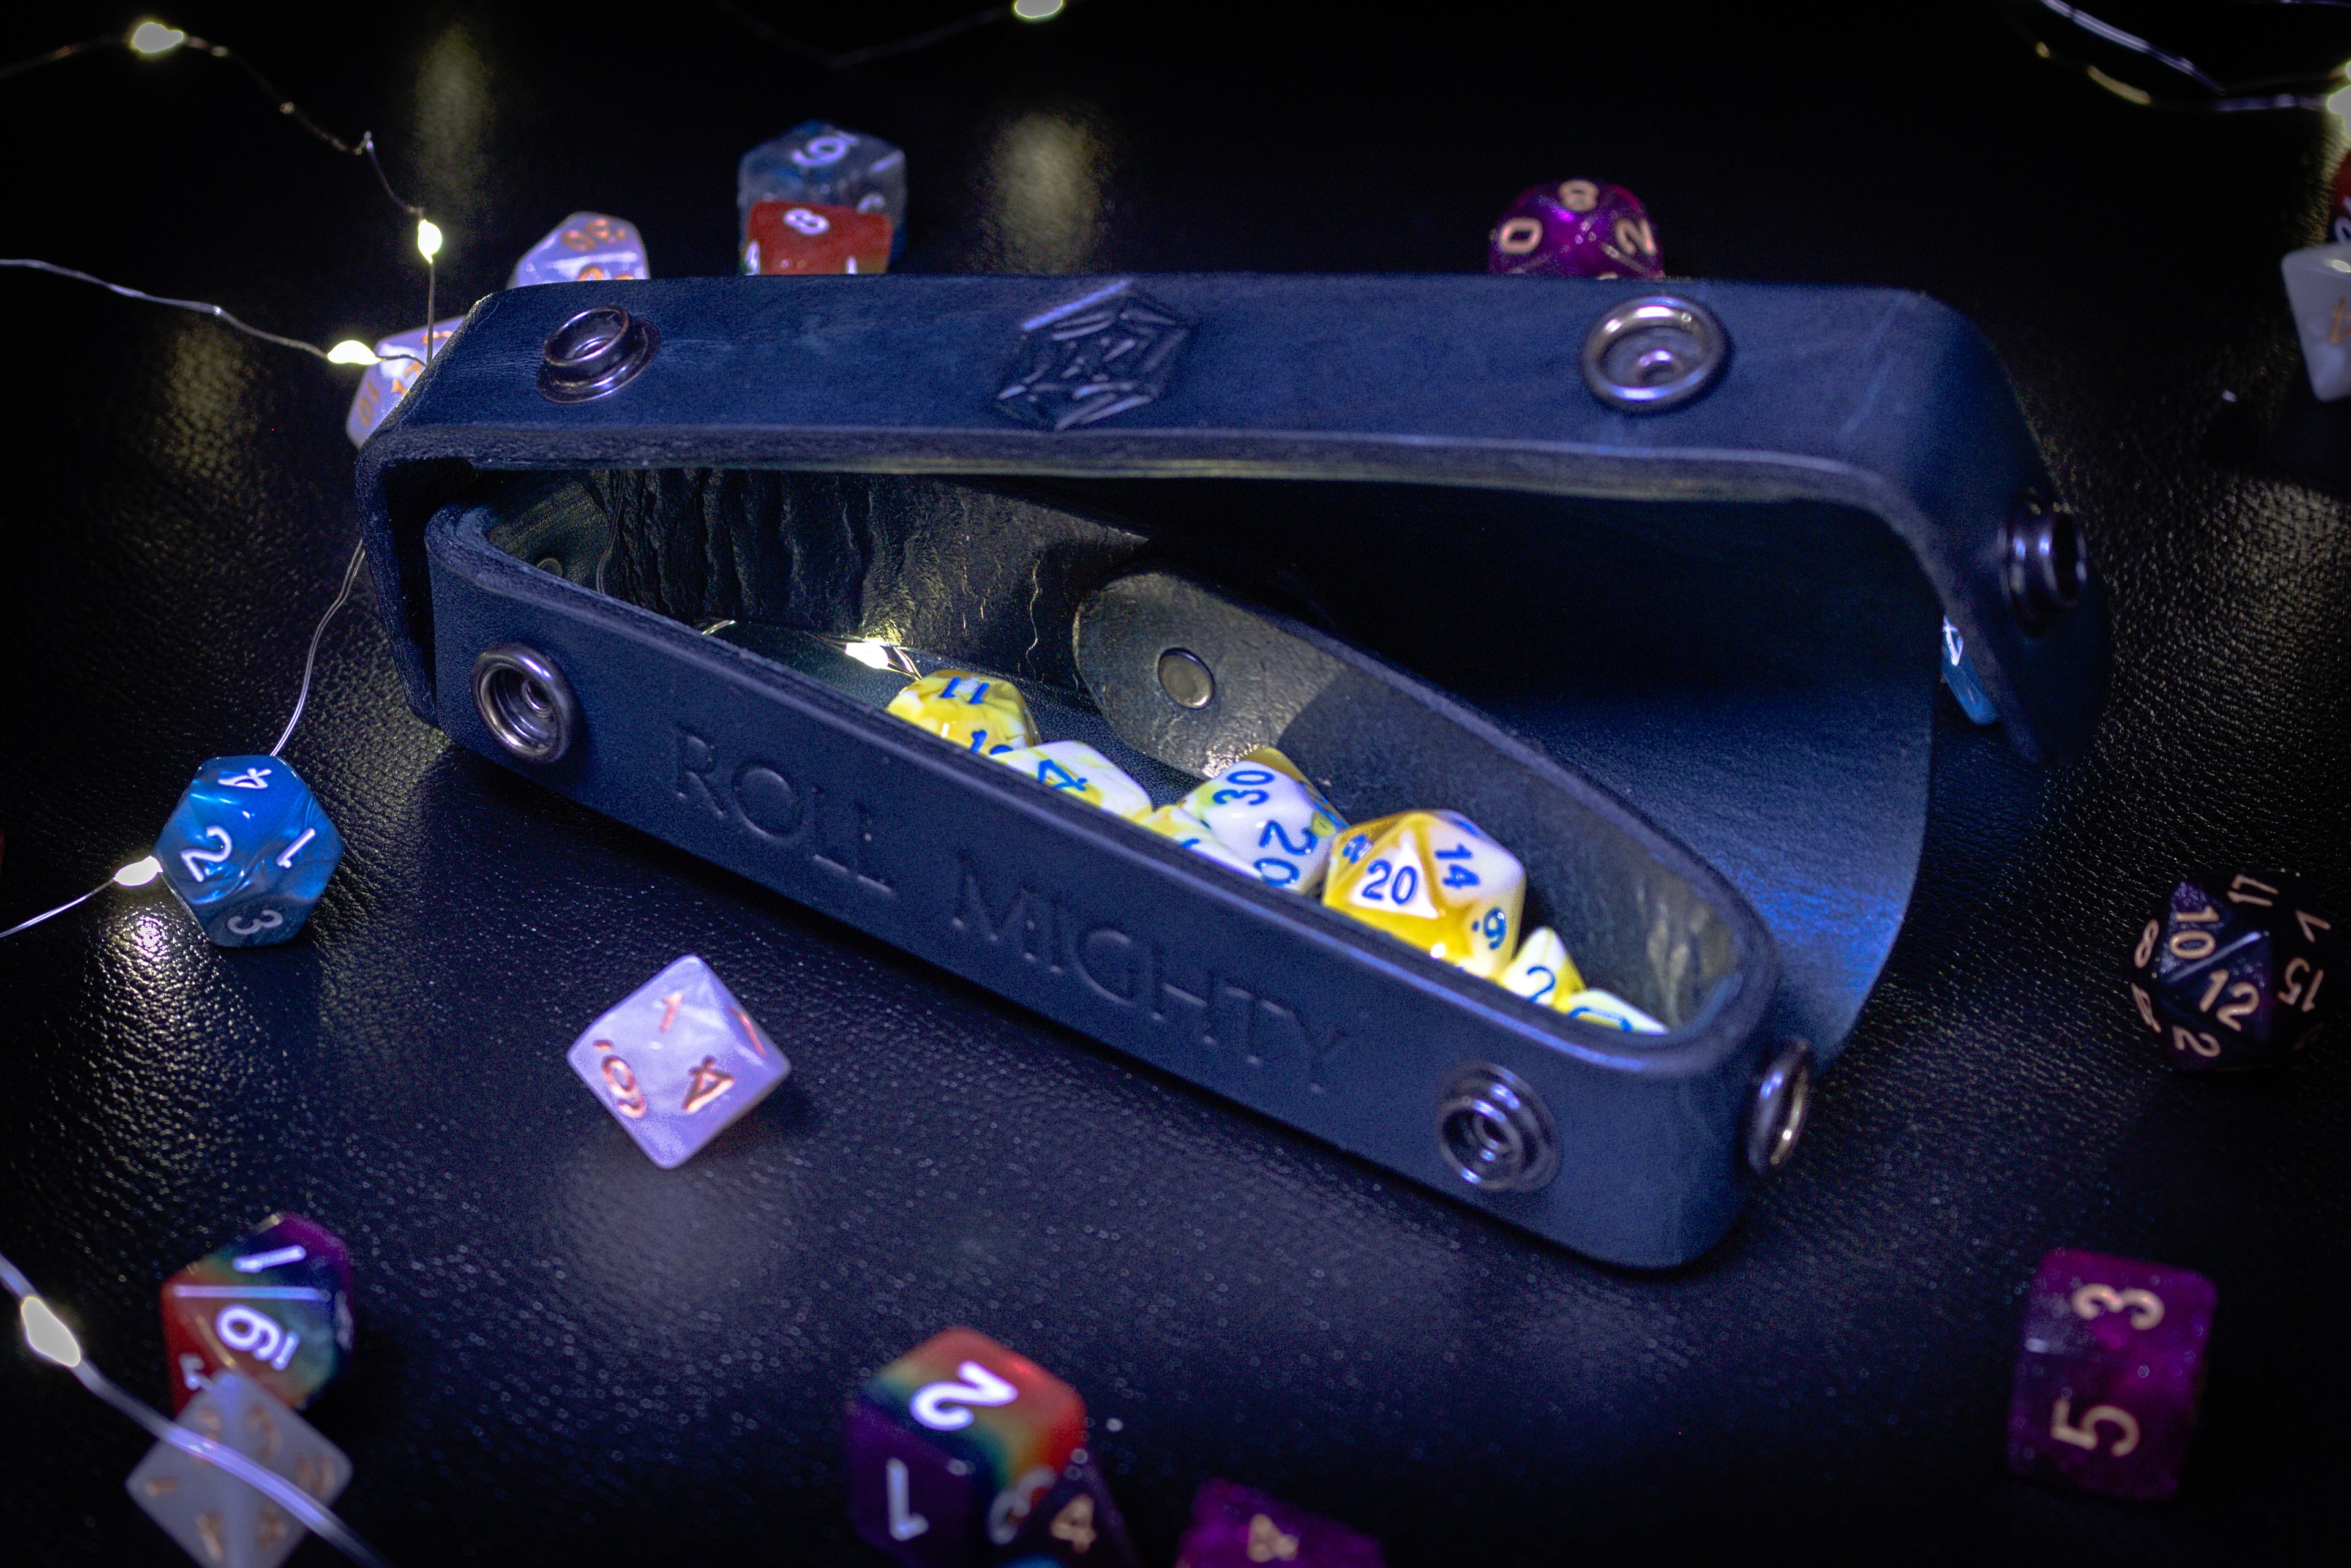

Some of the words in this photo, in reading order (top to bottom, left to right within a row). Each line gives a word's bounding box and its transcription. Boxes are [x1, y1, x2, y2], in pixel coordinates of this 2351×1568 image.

[1500, 217, 1543, 255] 0
[217, 768, 272, 790] 4
[1212, 770, 1276, 806] 30
[180, 825, 233, 882] 2
[276, 827, 316, 869] 1
[1253, 819, 1319, 888] 20
[1434, 842, 1480, 890] 14
[675, 722, 894, 898] ROLL
[953, 849, 1363, 1092] MIGHTY
[1362, 858, 1419, 907] 20
[227, 909, 283, 936] 3
[2169, 904, 2221, 959] 10
[1527, 964, 1556, 1002] 2
[2199, 969, 2260, 1032] 12
[2276, 956, 2325, 1012] 15
[2172, 1026, 2221, 1057] 2
[682, 1056, 735, 1114] 4
[2071, 1283, 2165, 1330] 3
[910, 1360, 1019, 1431] 2
[2050, 1397, 2140, 1458] 5
